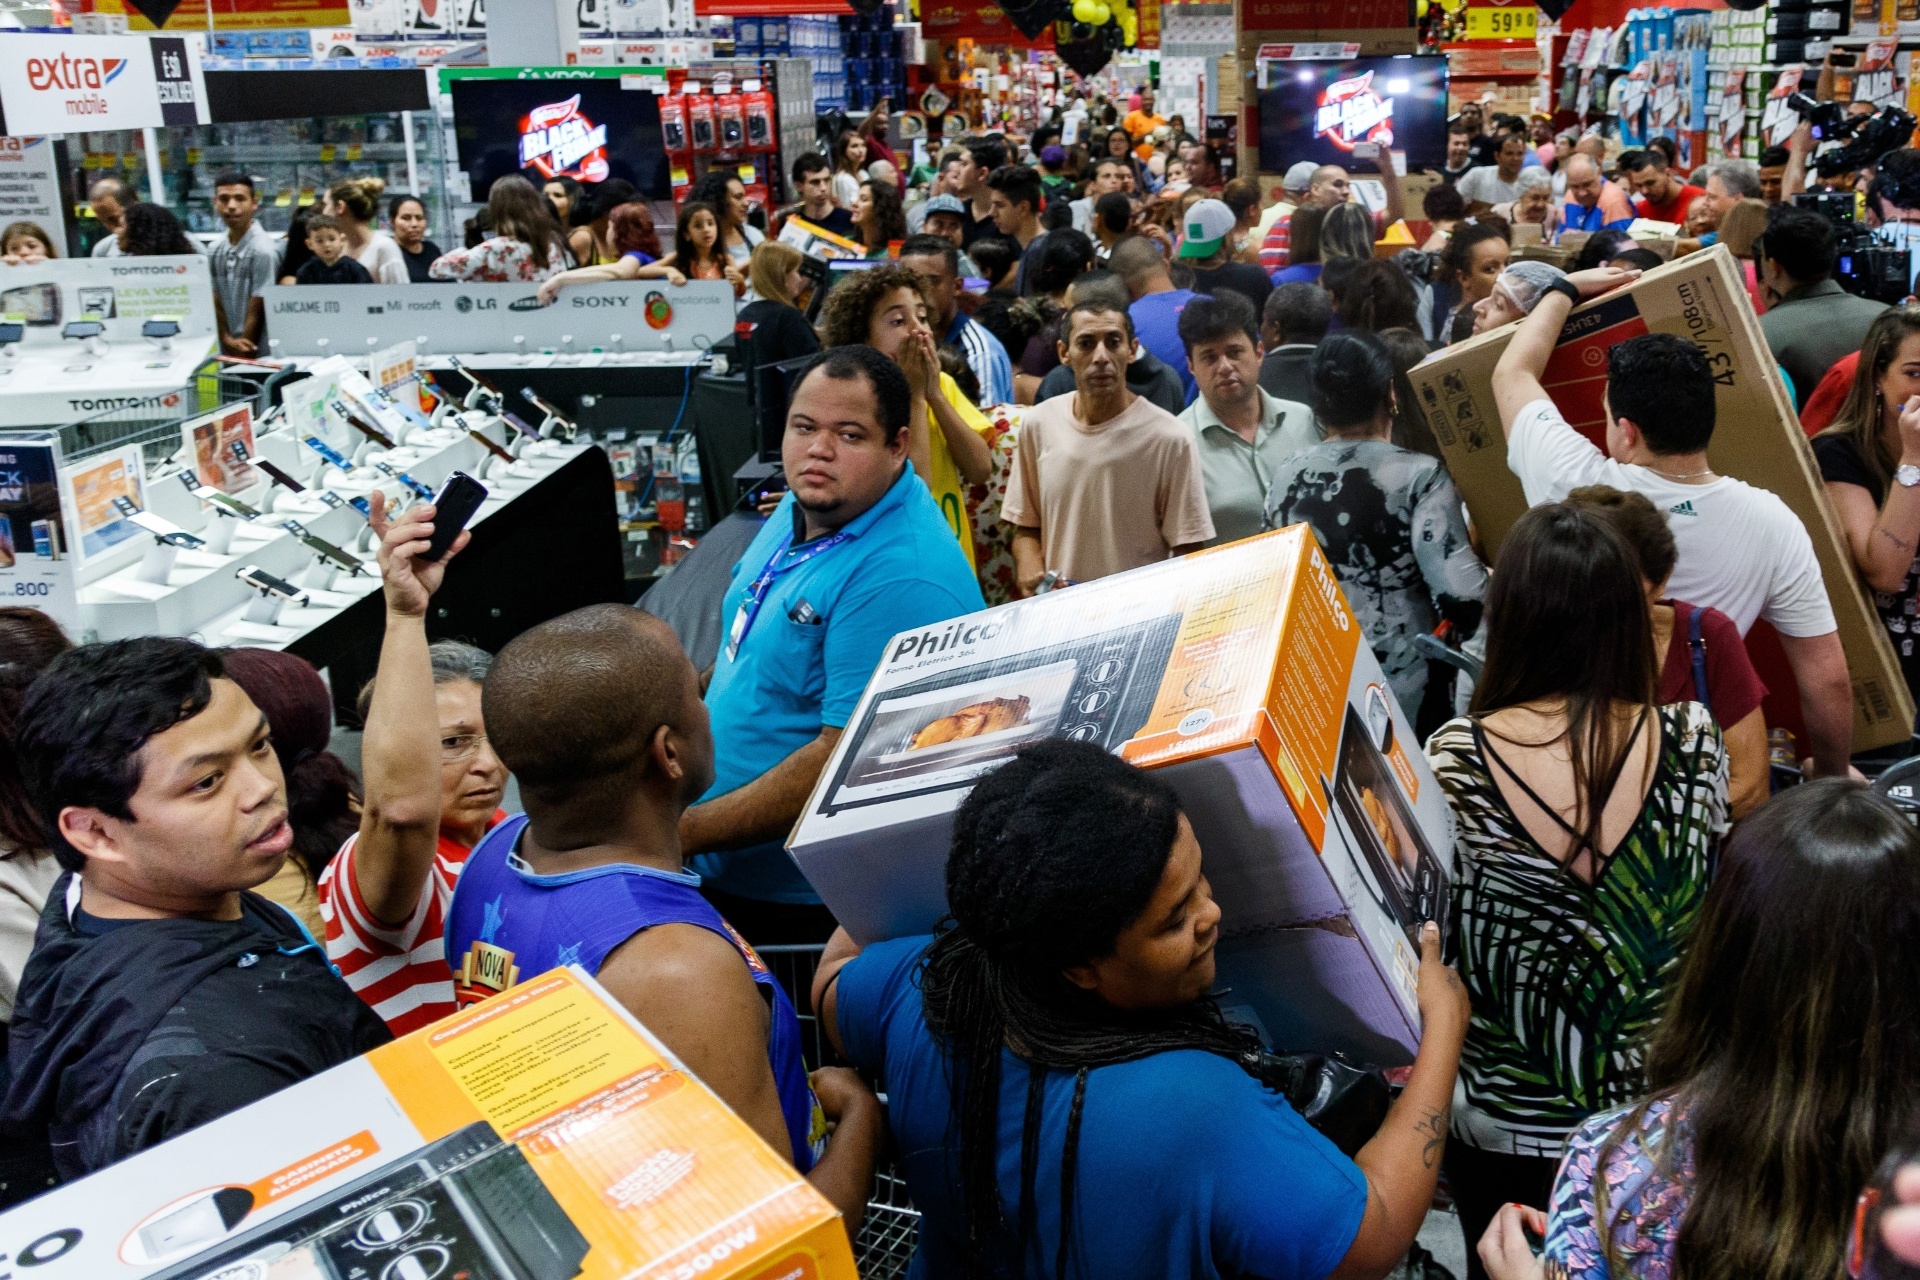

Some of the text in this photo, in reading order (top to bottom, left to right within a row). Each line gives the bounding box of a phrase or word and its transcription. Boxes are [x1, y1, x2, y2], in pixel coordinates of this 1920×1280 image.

[27, 52, 101, 91] extra
[65, 93, 108, 115] mobile
[477, 299, 497, 310] LG
[572, 296, 630, 308] SONY
[15, 582, 48, 596] 800
[1310, 546, 1349, 632] Philco
[890, 622, 1001, 664] Philco
[1185, 715, 1209, 728] 127V
[474, 949, 506, 985] NOVA
[433, 1002, 509, 1042] Capacidade
[532, 978, 565, 997] litros
[448, 1041, 493, 1064] Controle
[510, 1003, 576, 1036] temperatura
[533, 1029, 579, 1055] controle
[452, 1044, 501, 1070] ajustável
[469, 1060, 525, 1092] individual
[543, 1022, 609, 1056] temperatura
[470, 1044, 533, 1077] resistências
[503, 1056, 552, 1085] distribuir
[487, 1093, 527, 1114] Grelha
[502, 1100, 558, 1130] Assadeira
[269, 1148, 364, 1198] ALONGADO
[273, 1144, 352, 1186] GABINETE
[339, 1187, 391, 1214] Philco
